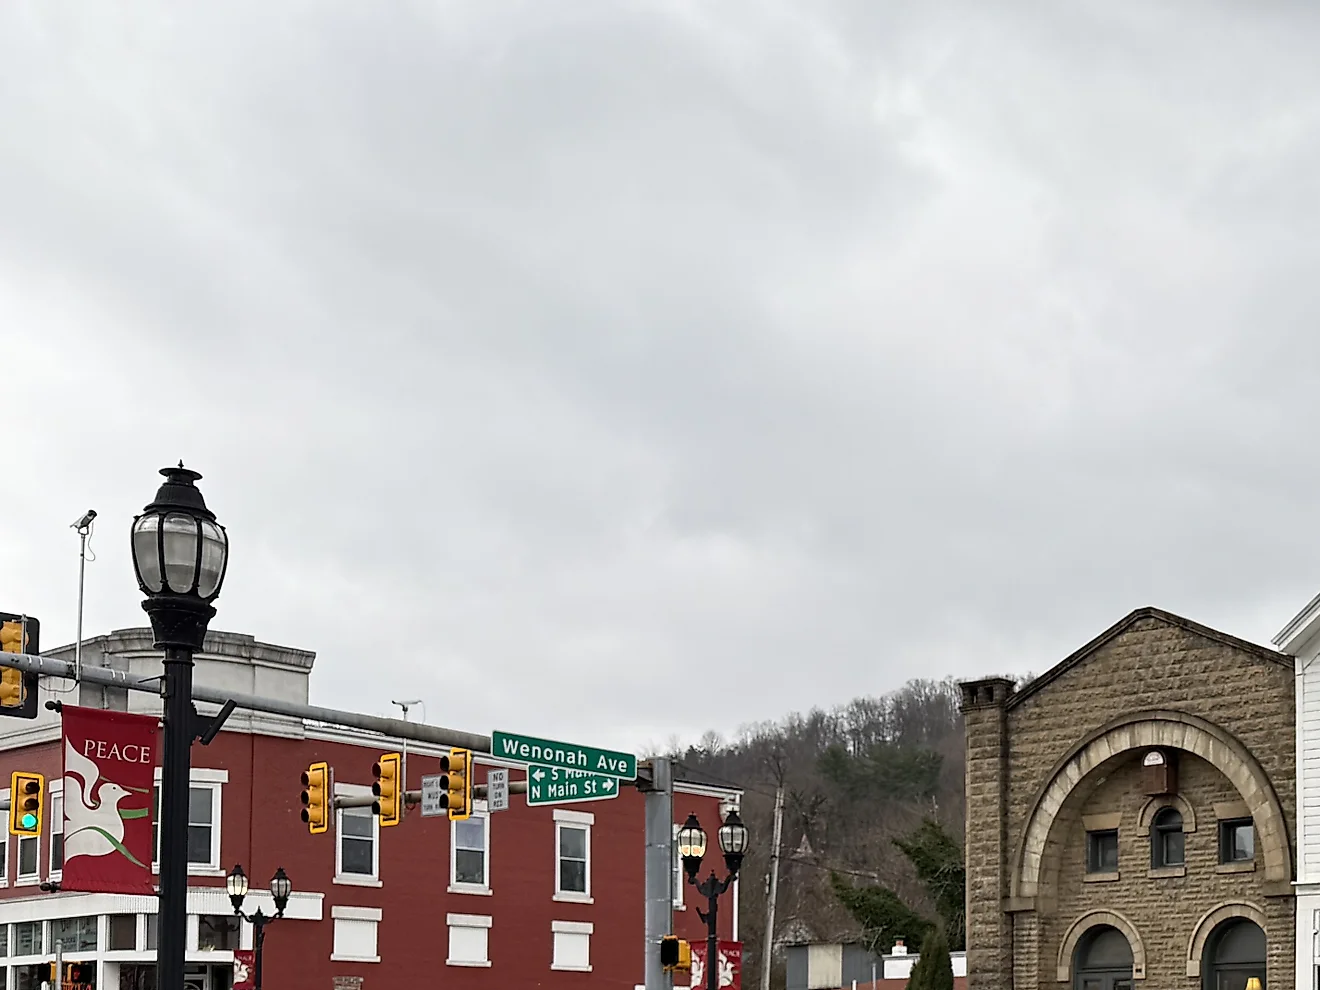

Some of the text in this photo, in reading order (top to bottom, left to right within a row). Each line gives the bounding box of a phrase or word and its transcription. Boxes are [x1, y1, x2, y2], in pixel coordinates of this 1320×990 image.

[84, 739, 151, 764] PEACE
[502, 738, 628, 773] Wenonah Ave
[493, 772, 504, 781] NO
[551, 767, 559, 780] S
[531, 780, 597, 799] N Main St
